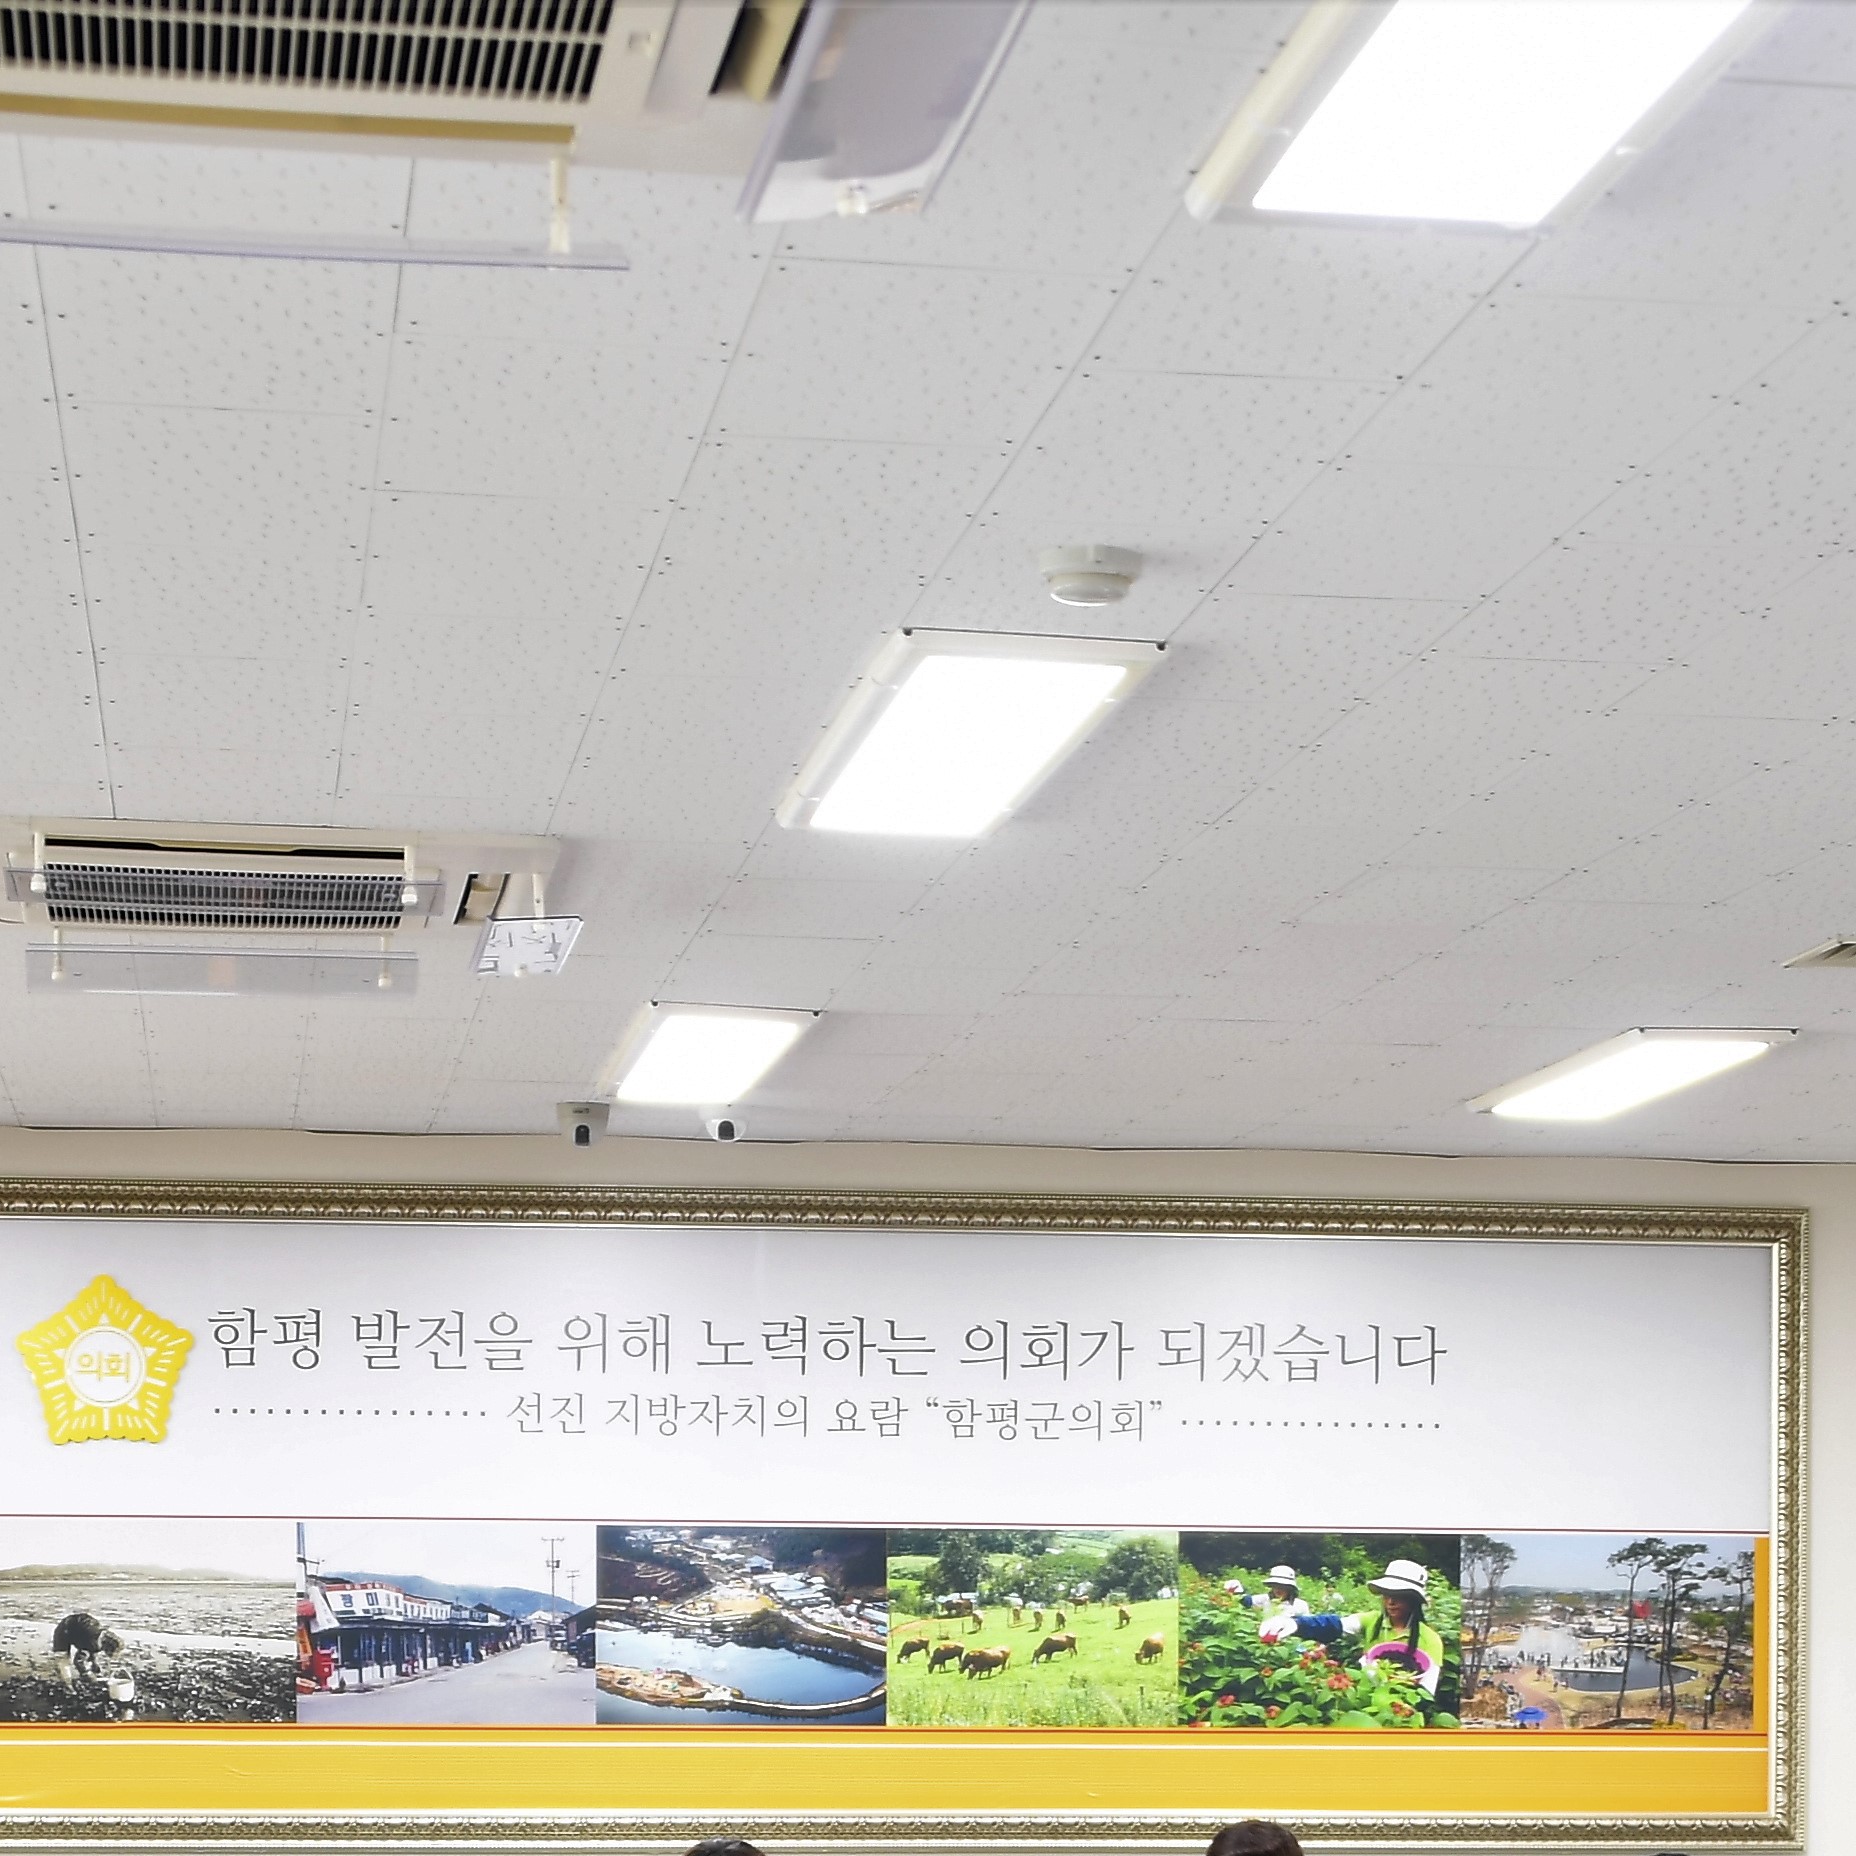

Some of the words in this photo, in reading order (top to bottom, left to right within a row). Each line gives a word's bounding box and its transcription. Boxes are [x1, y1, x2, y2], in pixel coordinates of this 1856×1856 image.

[75, 1352, 131, 1382] 의회
[208, 1307, 322, 1370] 함평
[352, 1310, 533, 1370] 발전을
[557, 1312, 671, 1374] 위해
[696, 1315, 936, 1377] 노력하는
[960, 1319, 1135, 1381] 의회가
[1157, 1322, 1448, 1386] 되겠습니다
[506, 1392, 586, 1434] 선진
[605, 1394, 808, 1437] 지방자치의
[827, 1396, 909, 1438] 요람
